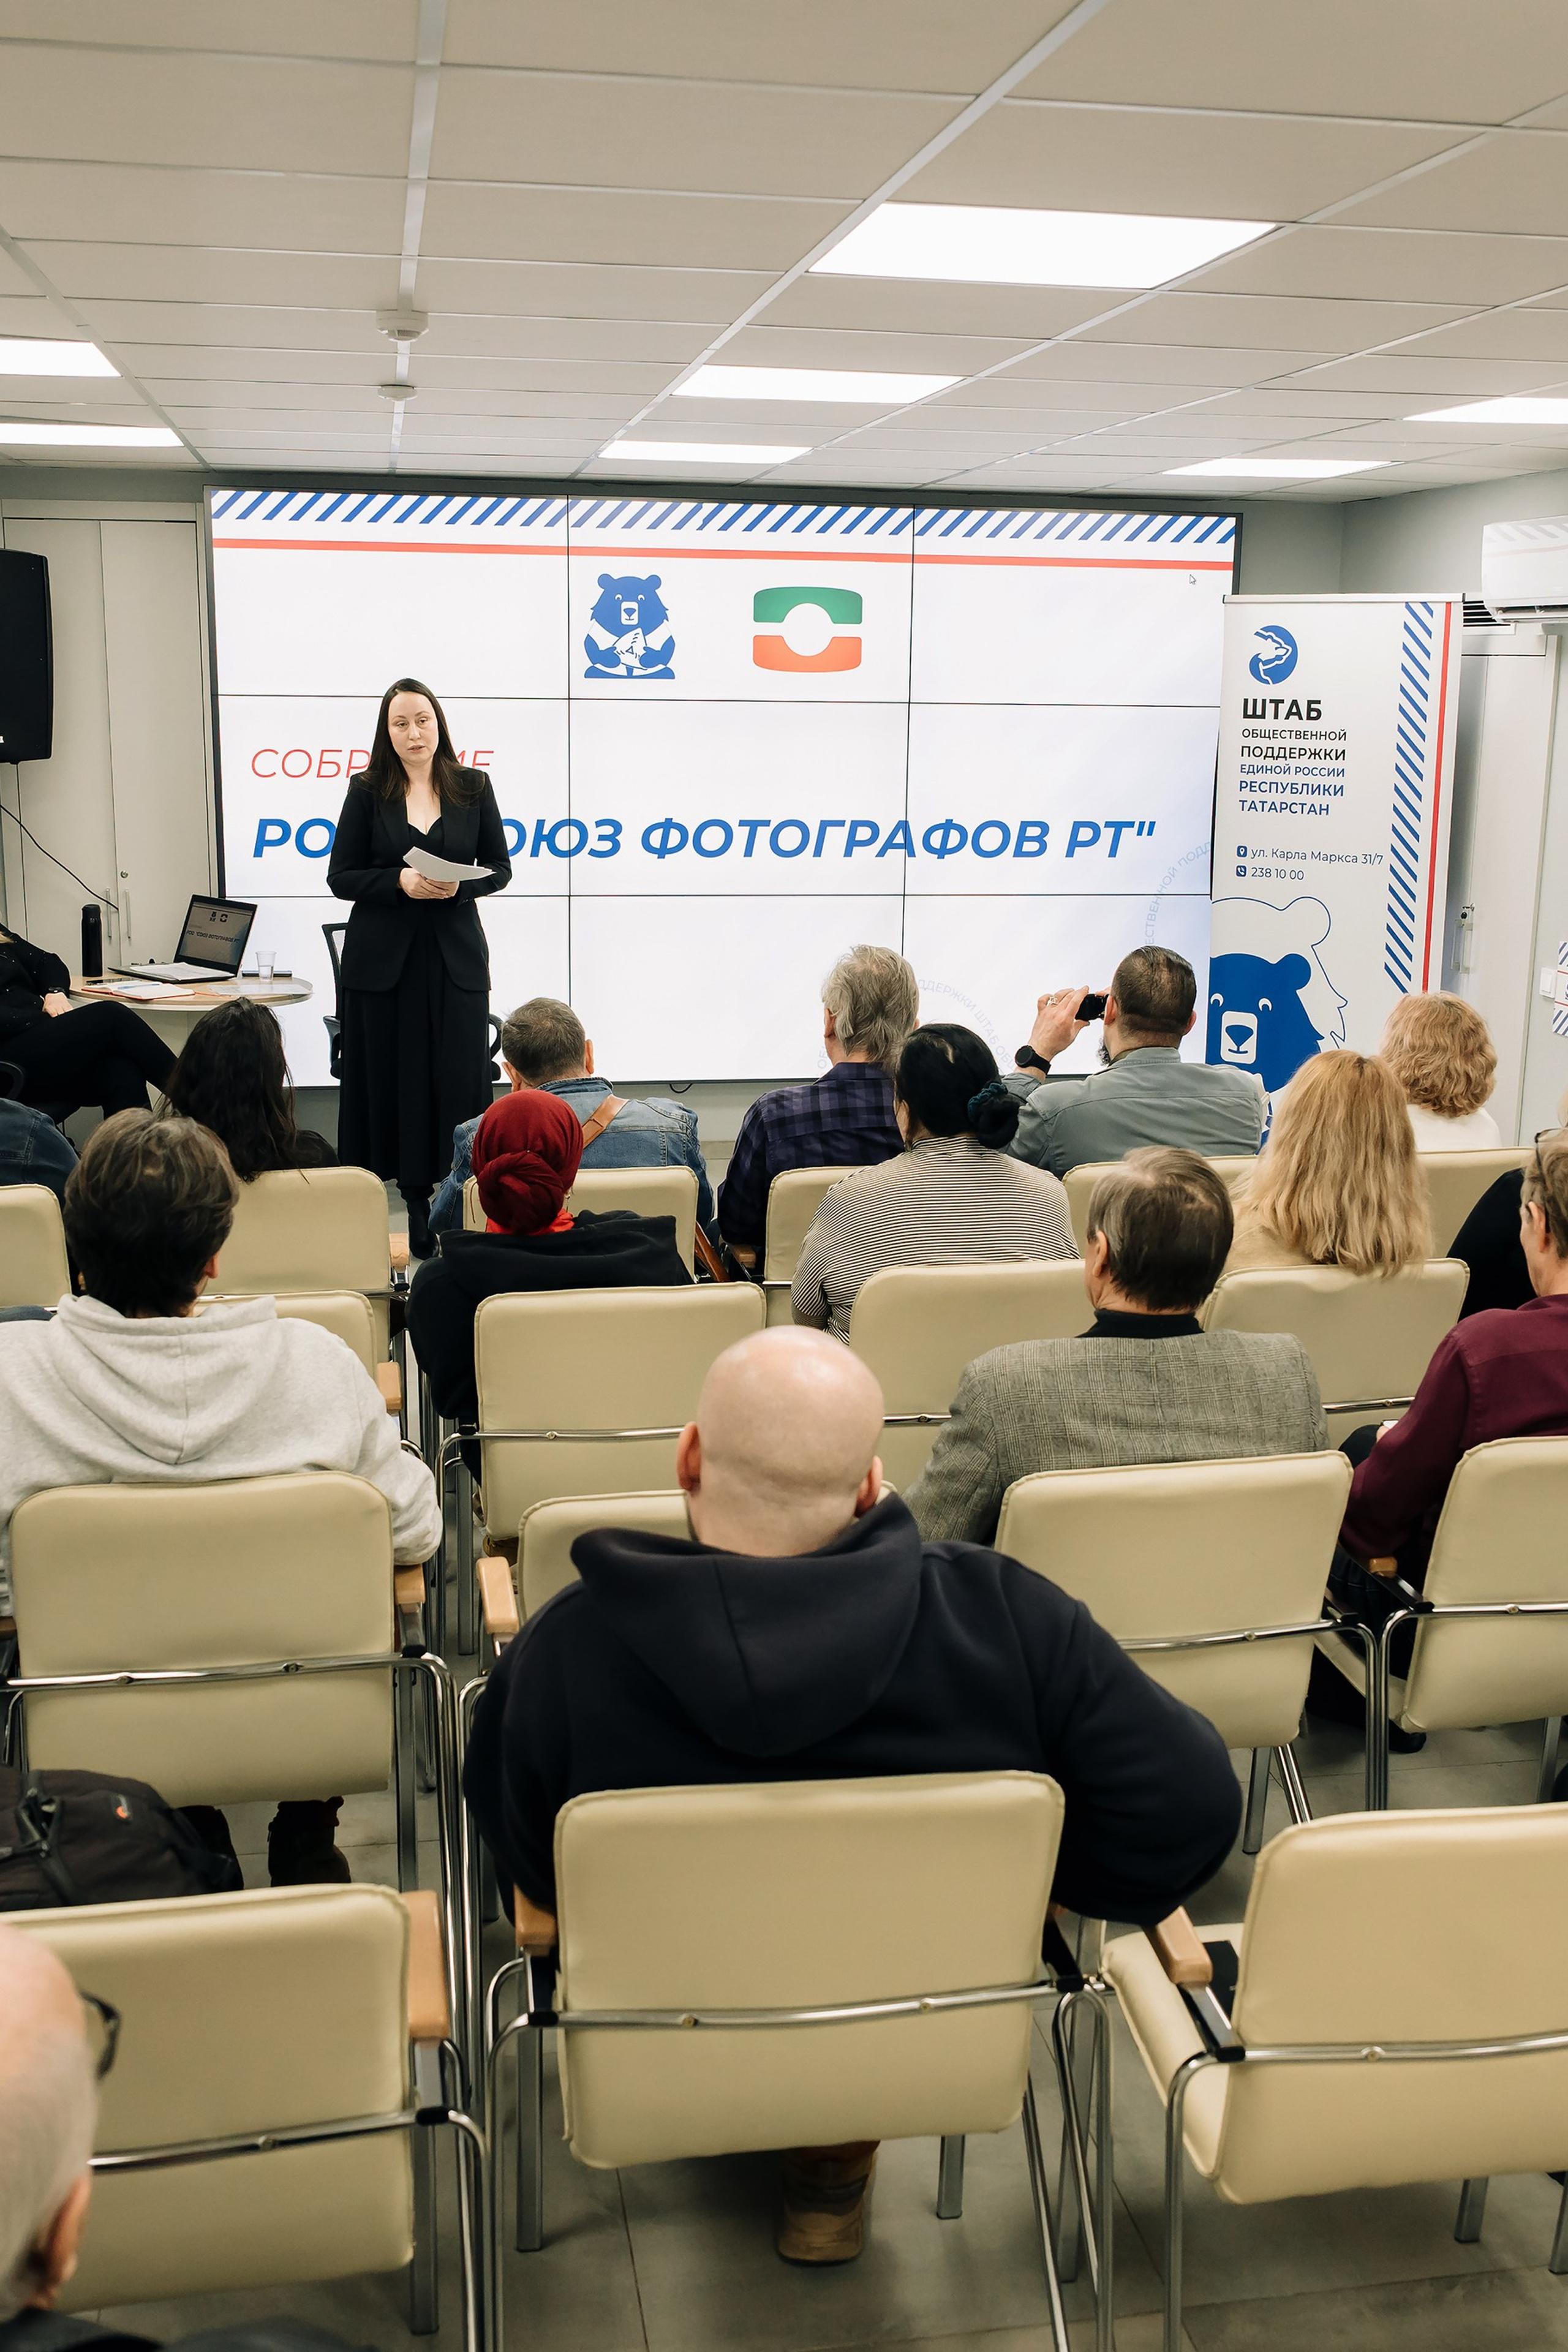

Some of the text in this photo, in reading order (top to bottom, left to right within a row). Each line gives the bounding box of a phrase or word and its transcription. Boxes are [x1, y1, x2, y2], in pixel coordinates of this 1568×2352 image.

[1242, 698, 1322, 721] ШТАБ
[1242, 728, 1347, 742] ОБЩЕСТВЕННОЙ
[1240, 745, 1346, 761] ПОДДЕРЖКИ
[251, 748, 494, 778] СОБРЕ
[1240, 763, 1345, 777] ЕДИНОЙ РОССИИ
[1239, 780, 1344, 797] РЕСПУБЛИКИ
[1239, 799, 1329, 816] ТАТАРСТАН
[253, 818, 336, 858] РО
[641, 818, 1048, 860] ФОТОГРАФОВ
[1065, 821, 1155, 858] РТ"
[1251, 848, 1384, 865] ул. Карла Маркса 31/7
[1251, 867, 1305, 880] 238 10 00
[1145, 866, 1177, 945] ЕСТВЕННОЙ
